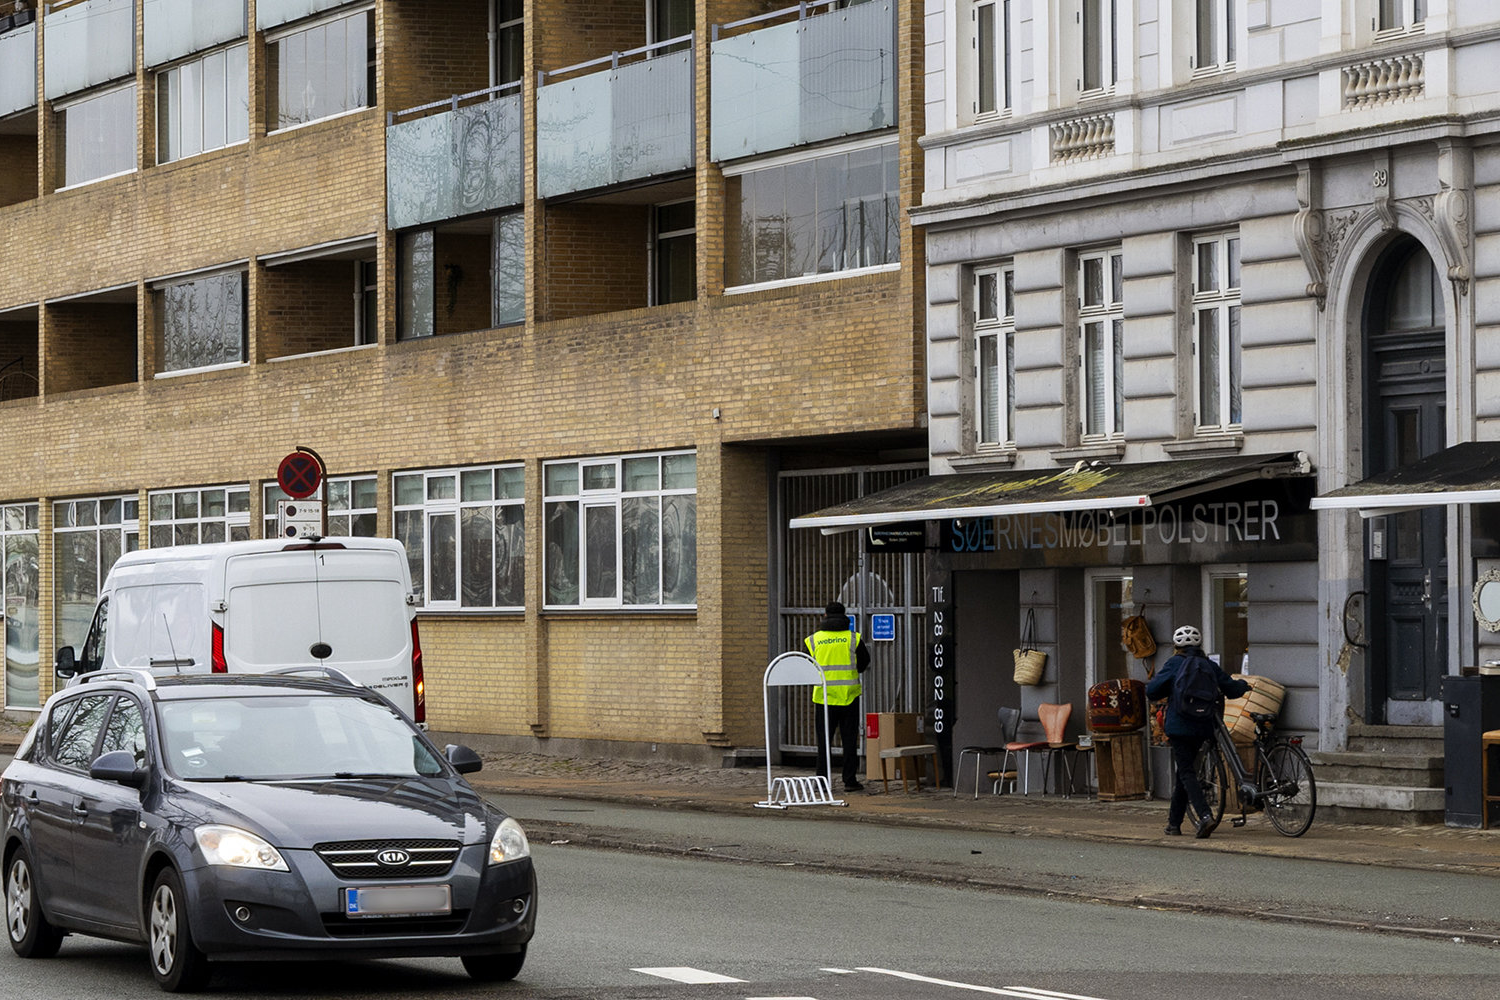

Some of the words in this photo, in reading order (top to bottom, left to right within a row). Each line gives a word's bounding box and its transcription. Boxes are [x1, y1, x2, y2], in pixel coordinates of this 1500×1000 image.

[951, 499, 1280, 551] SØERNESMØBELPOLSTRER
[319, 554, 325, 566] 1
[932, 586, 945, 602] Tlf.
[934, 611, 944, 636] 28
[817, 636, 847, 645] webrino
[934, 643, 944, 669] 33
[934, 675, 944, 701] 62
[934, 708, 944, 733] 89
[382, 852, 404, 861] KIA
